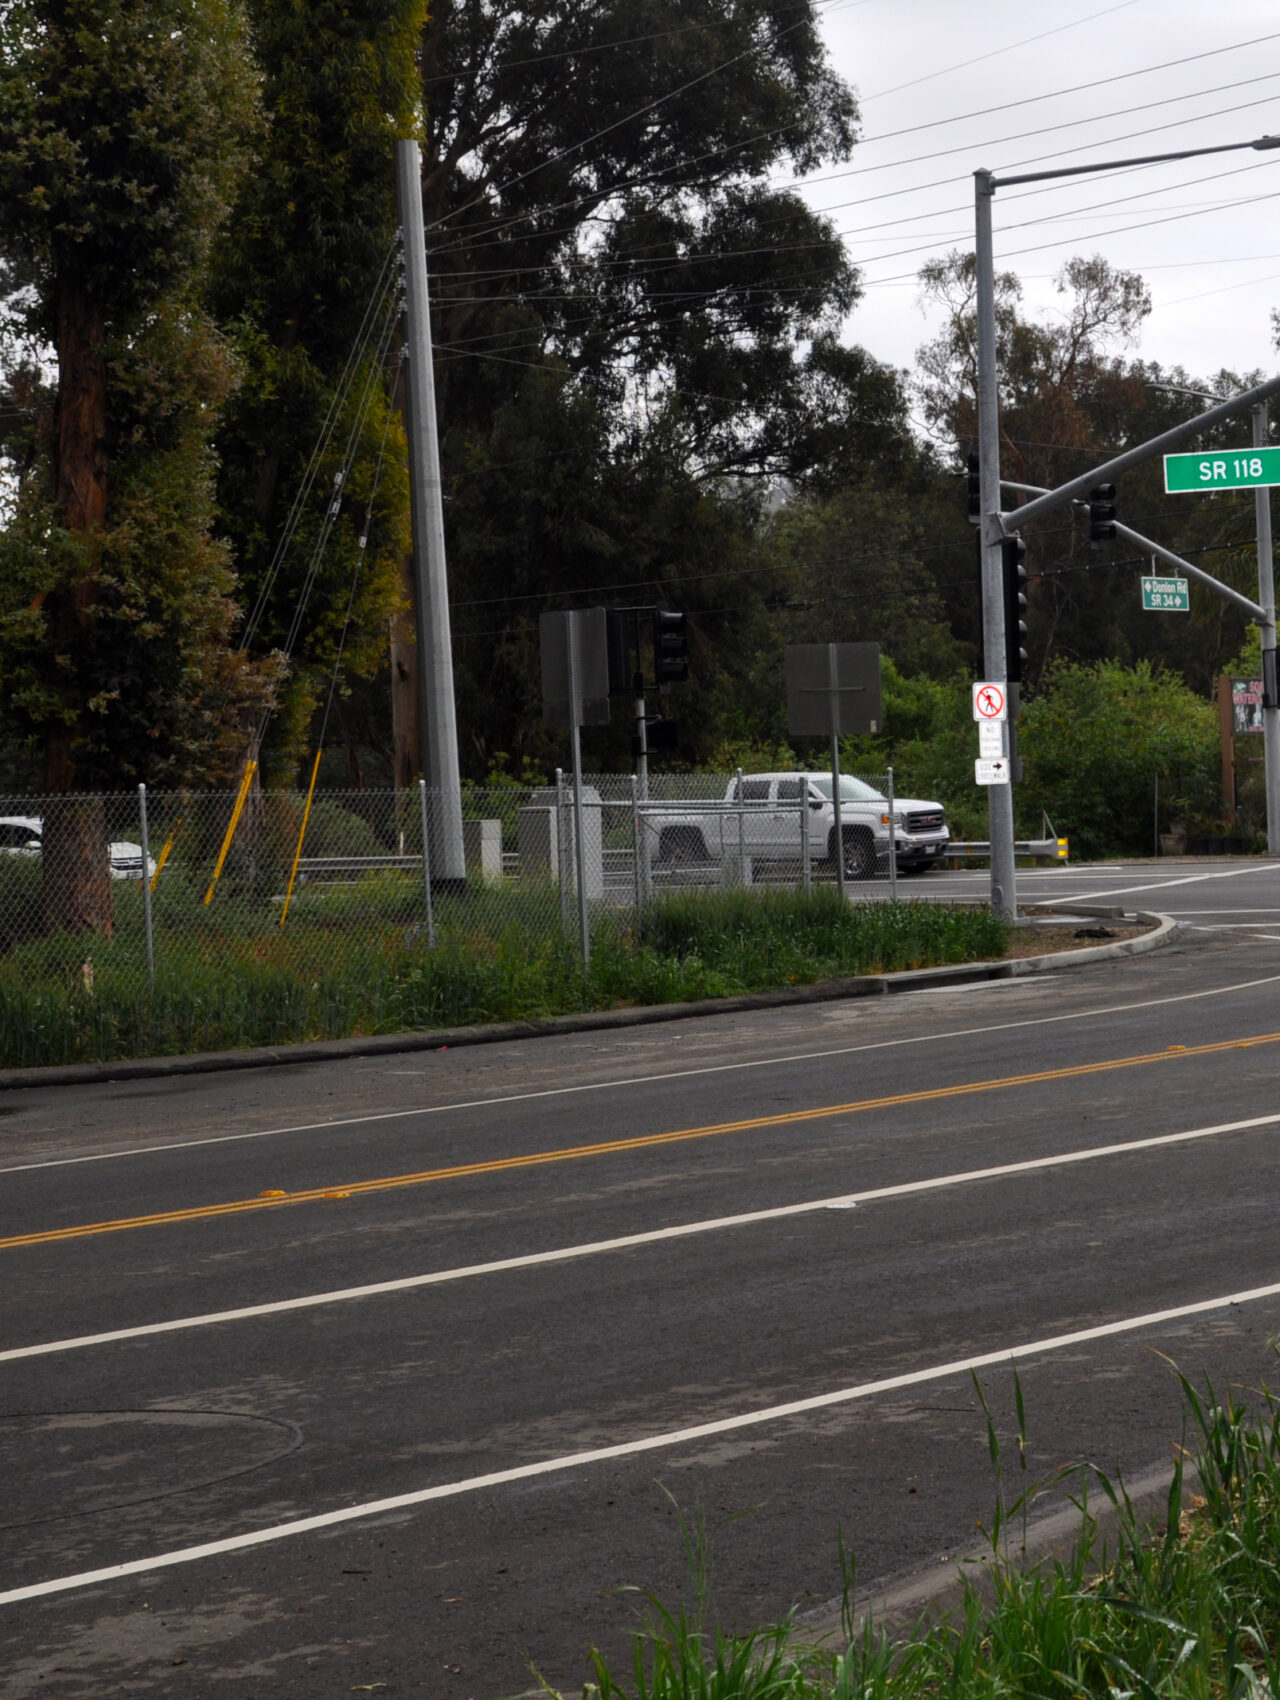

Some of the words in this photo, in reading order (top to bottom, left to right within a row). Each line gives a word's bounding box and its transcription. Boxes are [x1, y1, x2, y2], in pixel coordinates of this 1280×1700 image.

[1199, 461, 1227, 481] SR
[1233, 458, 1263, 478] 118
[1177, 582, 1187, 594] Rd
[1151, 594, 1161, 606] SR
[1163, 594, 1173, 607] 34
